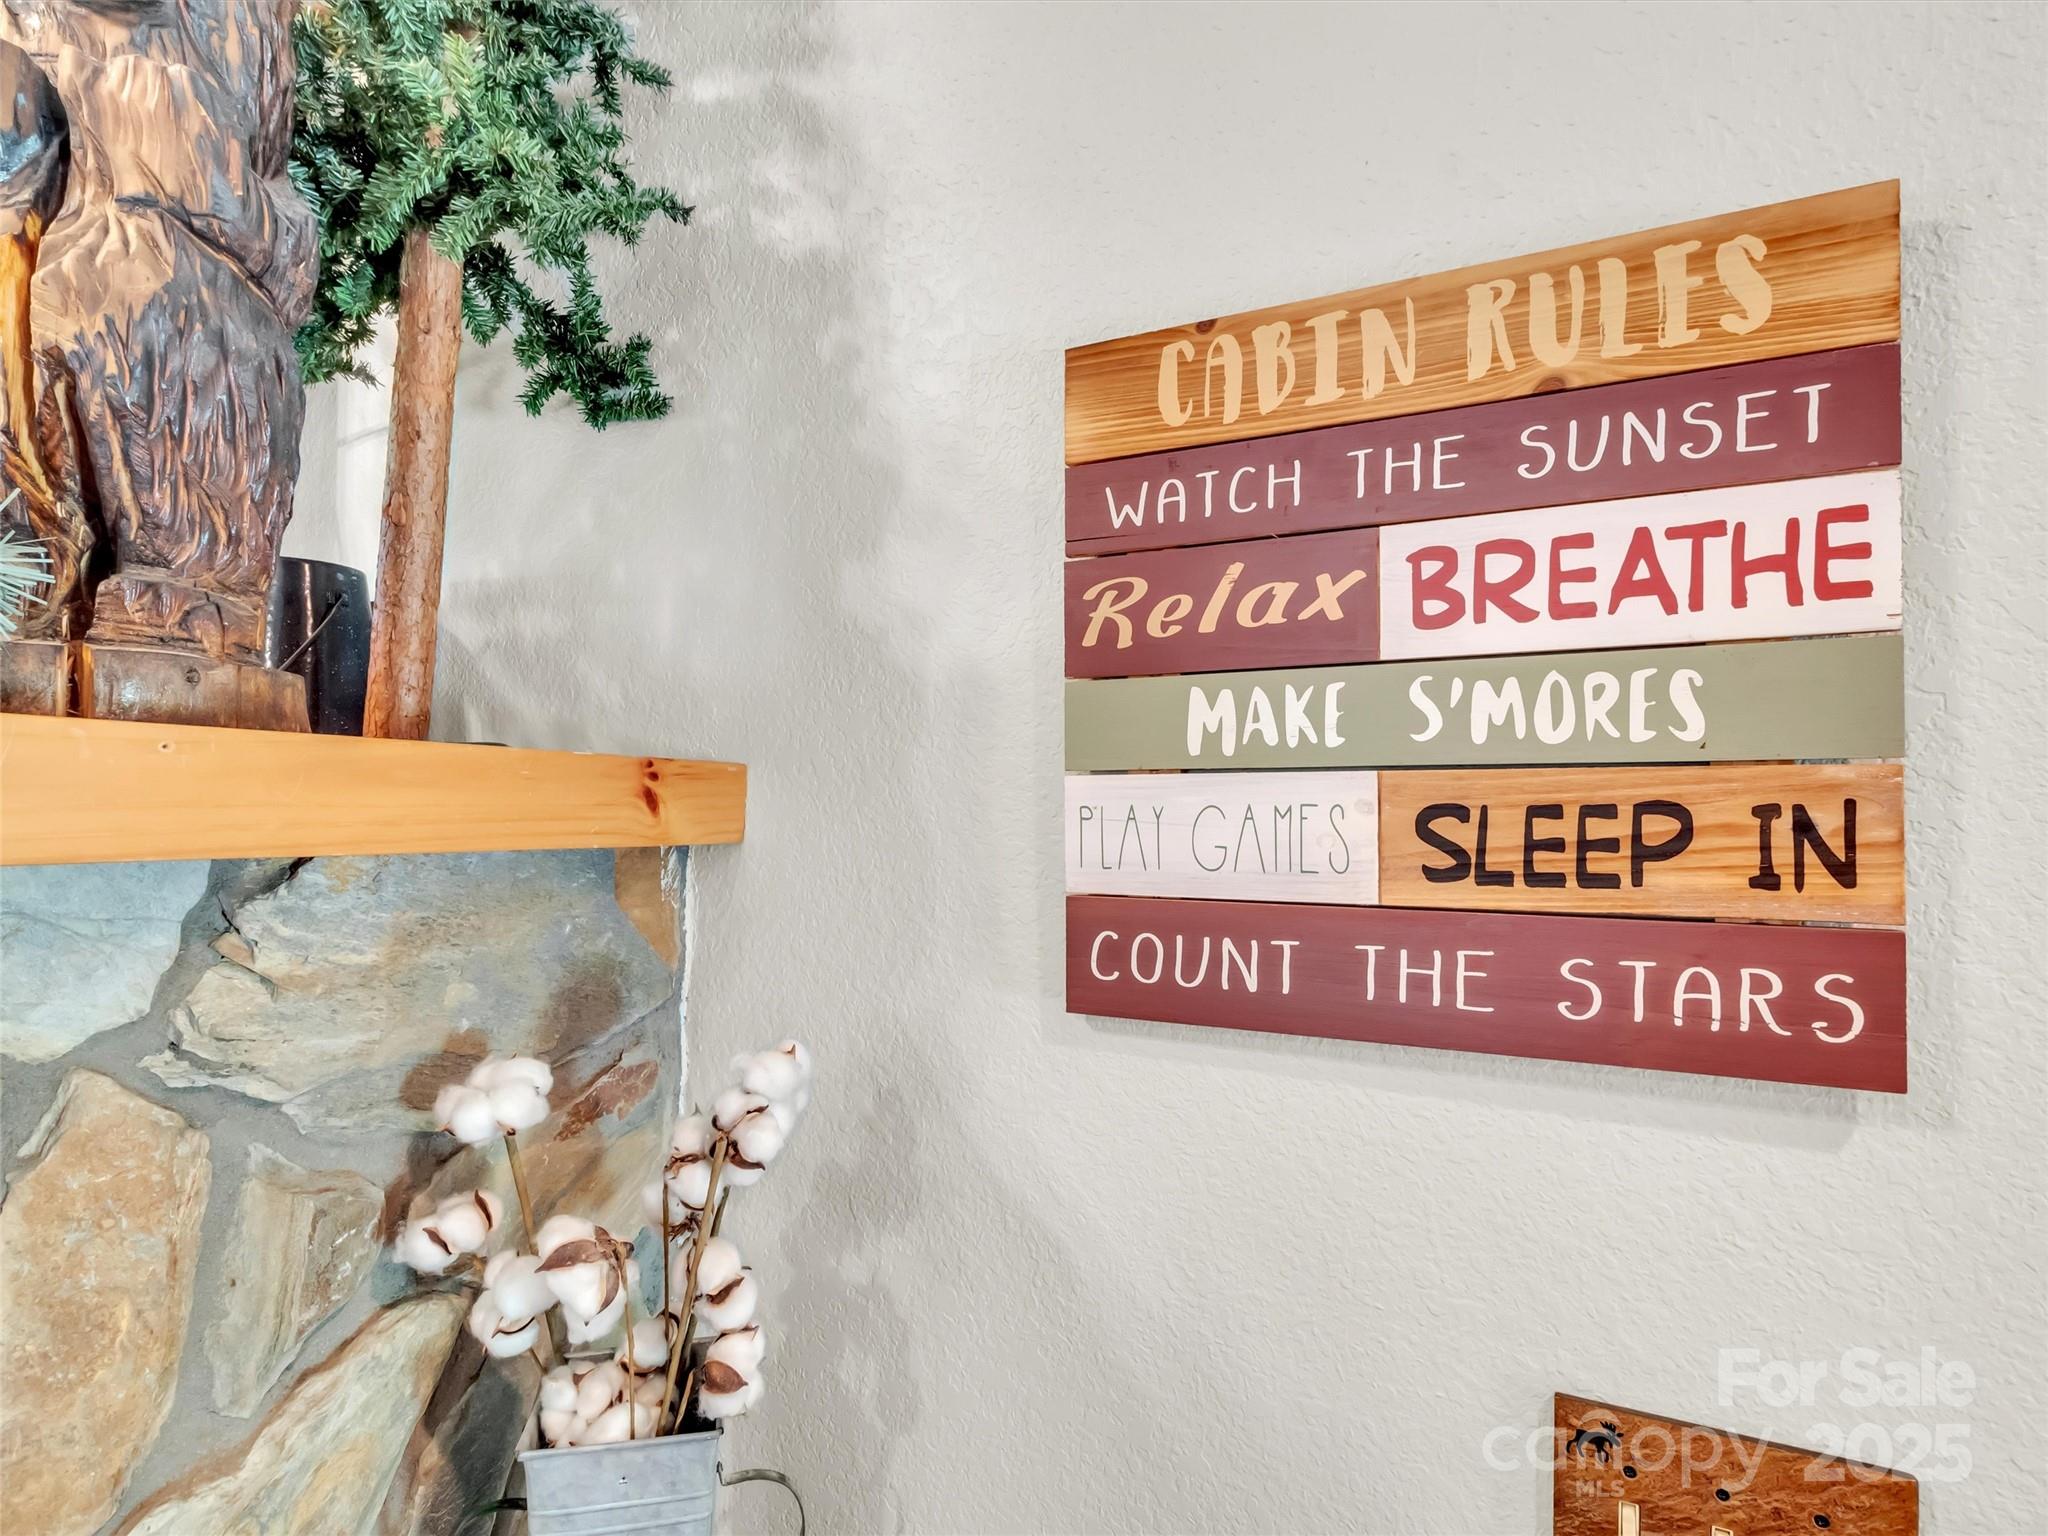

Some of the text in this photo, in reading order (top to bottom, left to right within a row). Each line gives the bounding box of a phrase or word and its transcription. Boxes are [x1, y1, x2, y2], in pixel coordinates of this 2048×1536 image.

[1157, 234, 1774, 427] CABIN RULES
[1105, 383, 1833, 529] WATCH THE SUNSET
[1081, 561, 1369, 650] Relax
[1406, 504, 1874, 630] BREATHE
[1186, 666, 1707, 757] MAKE S'MORES
[1079, 804, 1350, 875] PLAY GAMES
[1415, 798, 1858, 893] SLEEP IN
[1090, 931, 1865, 1044] COUNT THE STARS
